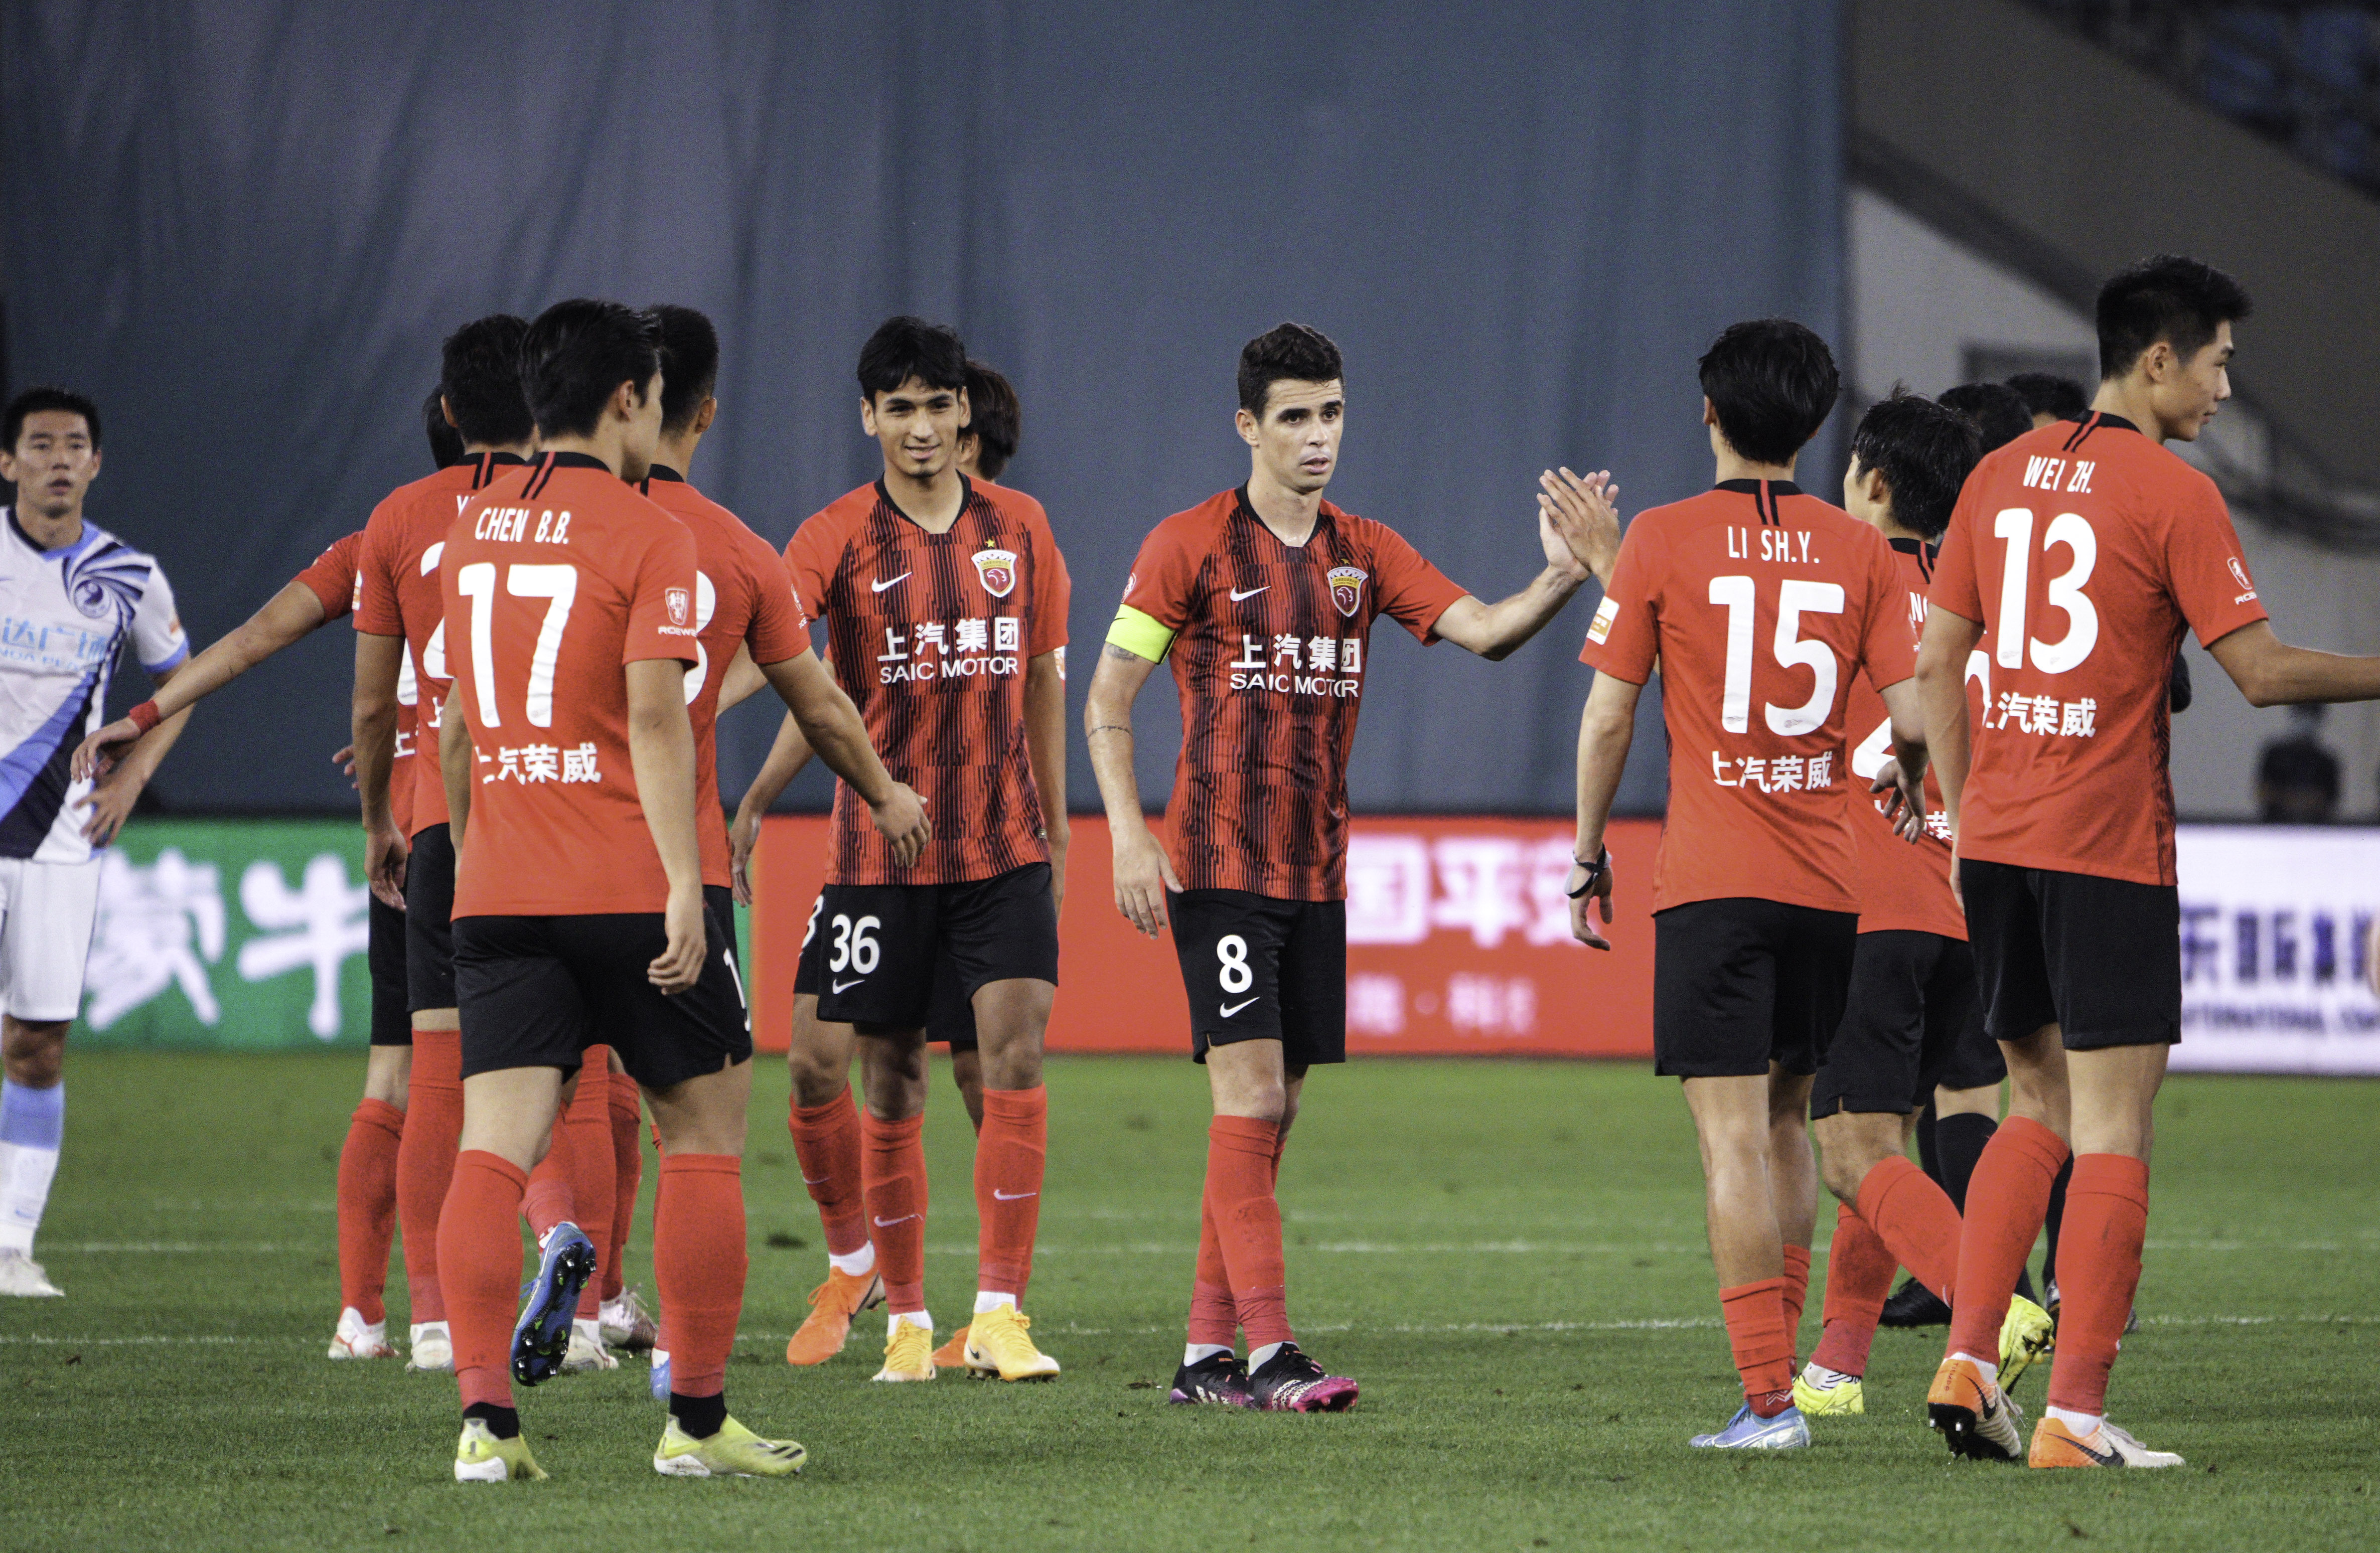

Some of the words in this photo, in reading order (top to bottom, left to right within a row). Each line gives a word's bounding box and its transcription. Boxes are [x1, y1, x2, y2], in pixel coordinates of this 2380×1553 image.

[2022, 454, 2065, 491] WEI
[2066, 460, 2096, 494] ZH.
[475, 507, 528, 542] CHEN
[534, 510, 571, 545] B.B.
[1727, 525, 1748, 559] LI
[1760, 529, 1820, 564] SH.Y.
[1994, 508, 2099, 674] 13
[458, 562, 578, 728] 17
[876, 616, 1019, 662] 上汽集团
[1230, 633, 1361, 673] 上汽集团
[1708, 575, 1845, 736] 15
[879, 662, 935, 684] SAIC
[941, 656, 1018, 679] MOTOR
[1230, 673, 1290, 693] SAIC
[1294, 676, 1359, 698] MOTOR
[1712, 750, 1833, 794] 上汽荣威
[829, 913, 881, 974] 36
[1216, 933, 1253, 994] 8
